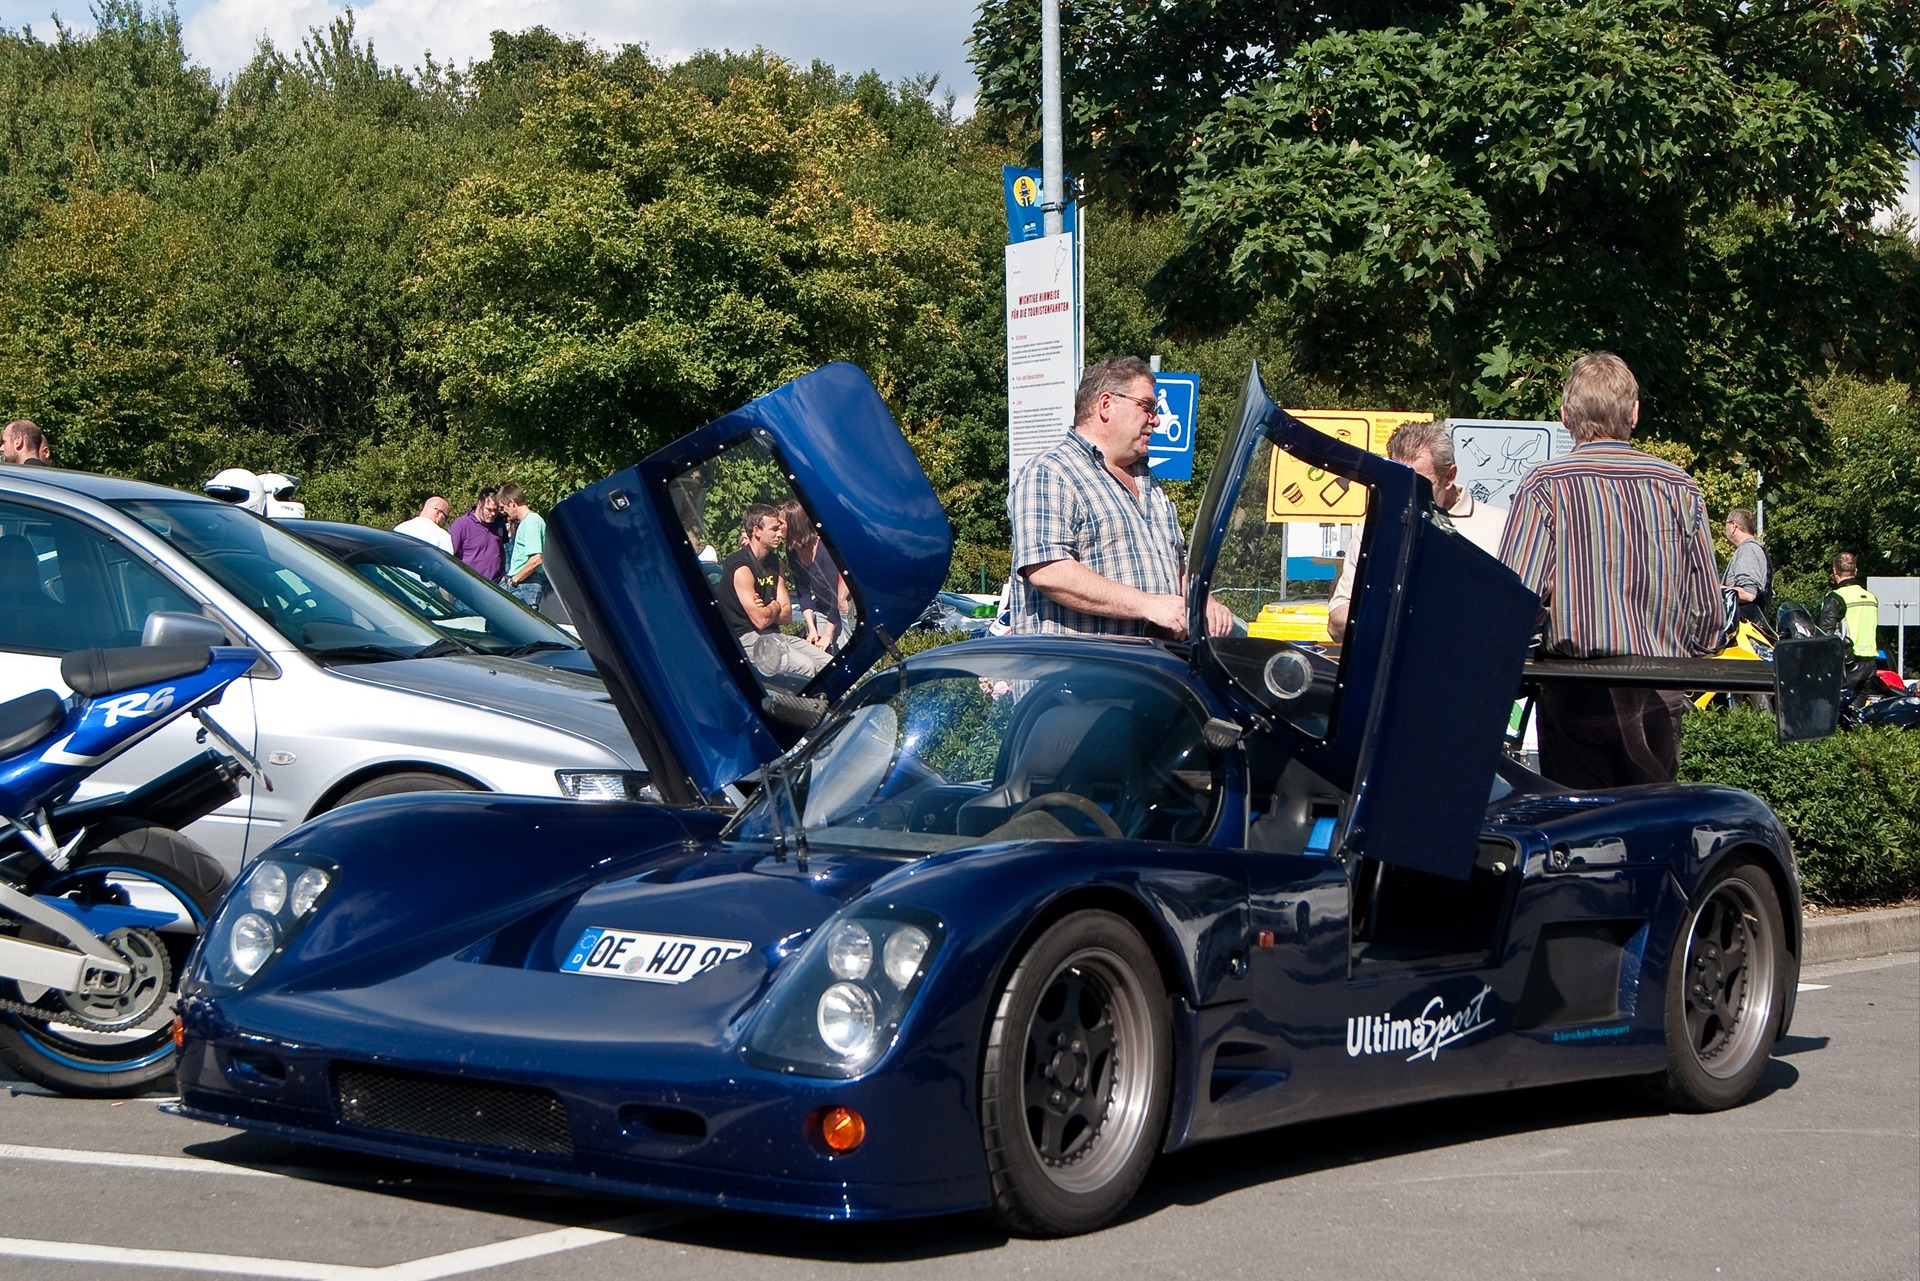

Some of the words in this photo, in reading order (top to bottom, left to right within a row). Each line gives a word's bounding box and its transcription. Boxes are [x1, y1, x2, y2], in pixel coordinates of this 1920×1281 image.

[1018, 293, 1038, 305] WICHTIGE
[1039, 290, 1060, 301] HINWEISE
[1011, 309, 1019, 319] FÜR
[1028, 302, 1069, 317] TOURISTENFAHRTEN
[95, 686, 176, 728] R6
[572, 954, 584, 964] D
[586, 935, 636, 969] OE
[646, 941, 697, 975] WD
